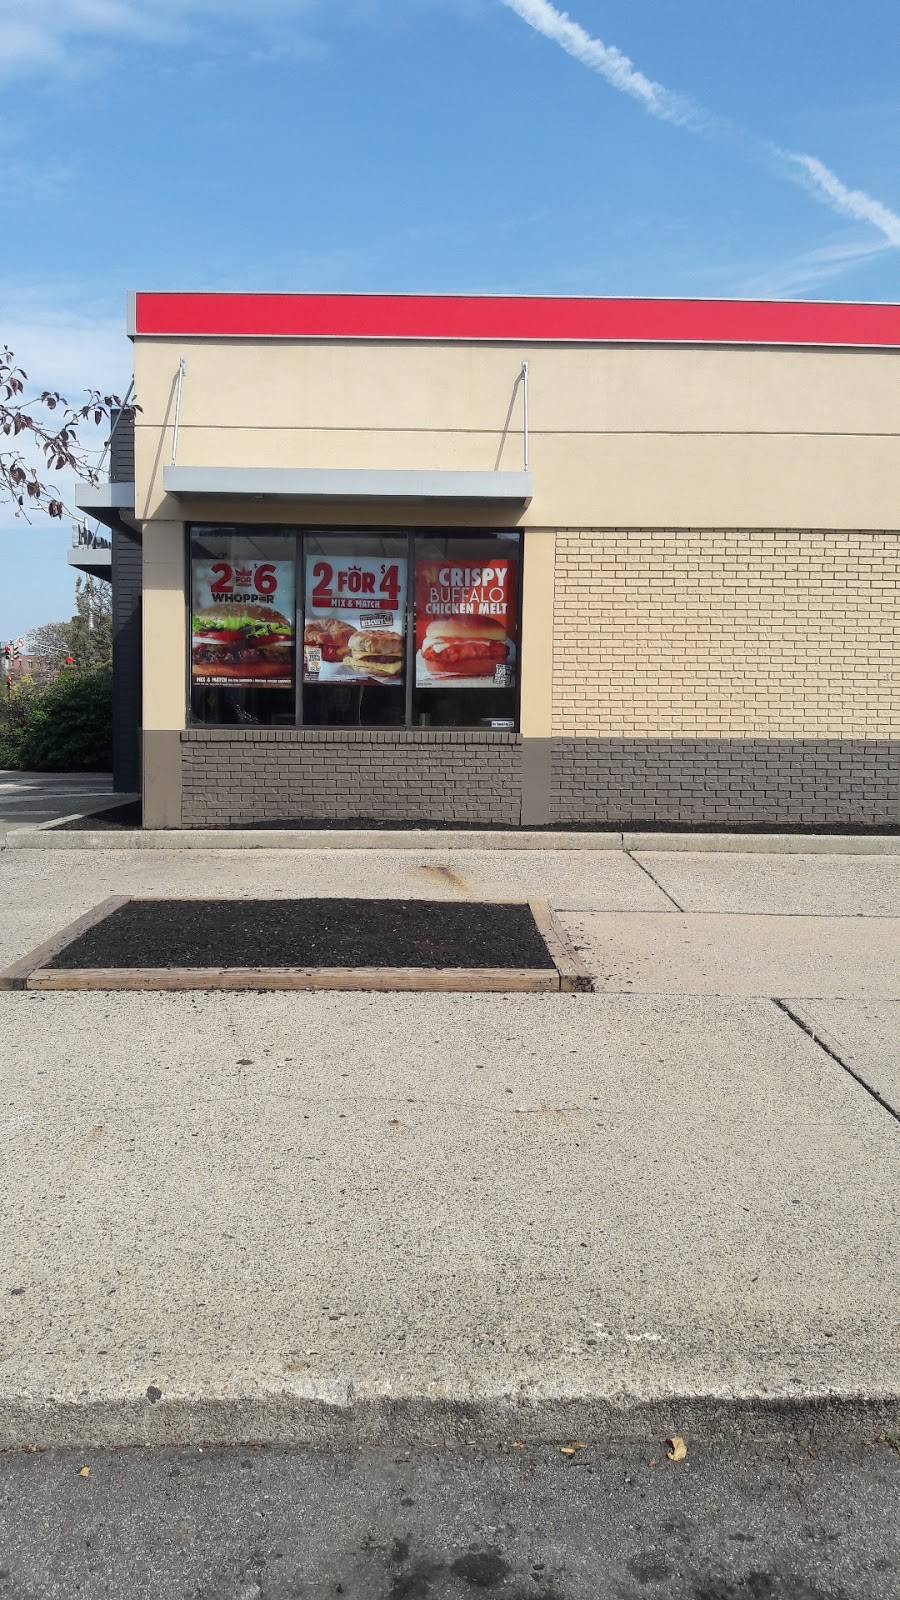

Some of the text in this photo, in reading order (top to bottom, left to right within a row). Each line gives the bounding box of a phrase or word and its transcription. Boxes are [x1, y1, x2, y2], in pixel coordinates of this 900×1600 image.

[211, 563, 233, 593] 2
[312, 562, 333, 596] 2
[338, 571, 376, 593] FOR
[438, 567, 508, 587] CRISPY
[212, 593, 275, 604] WHOPPER
[430, 587, 504, 603] BUFFALO
[331, 599, 380, 609] MIX & MATCH
[425, 603, 508, 615] CHICKEN MELT
